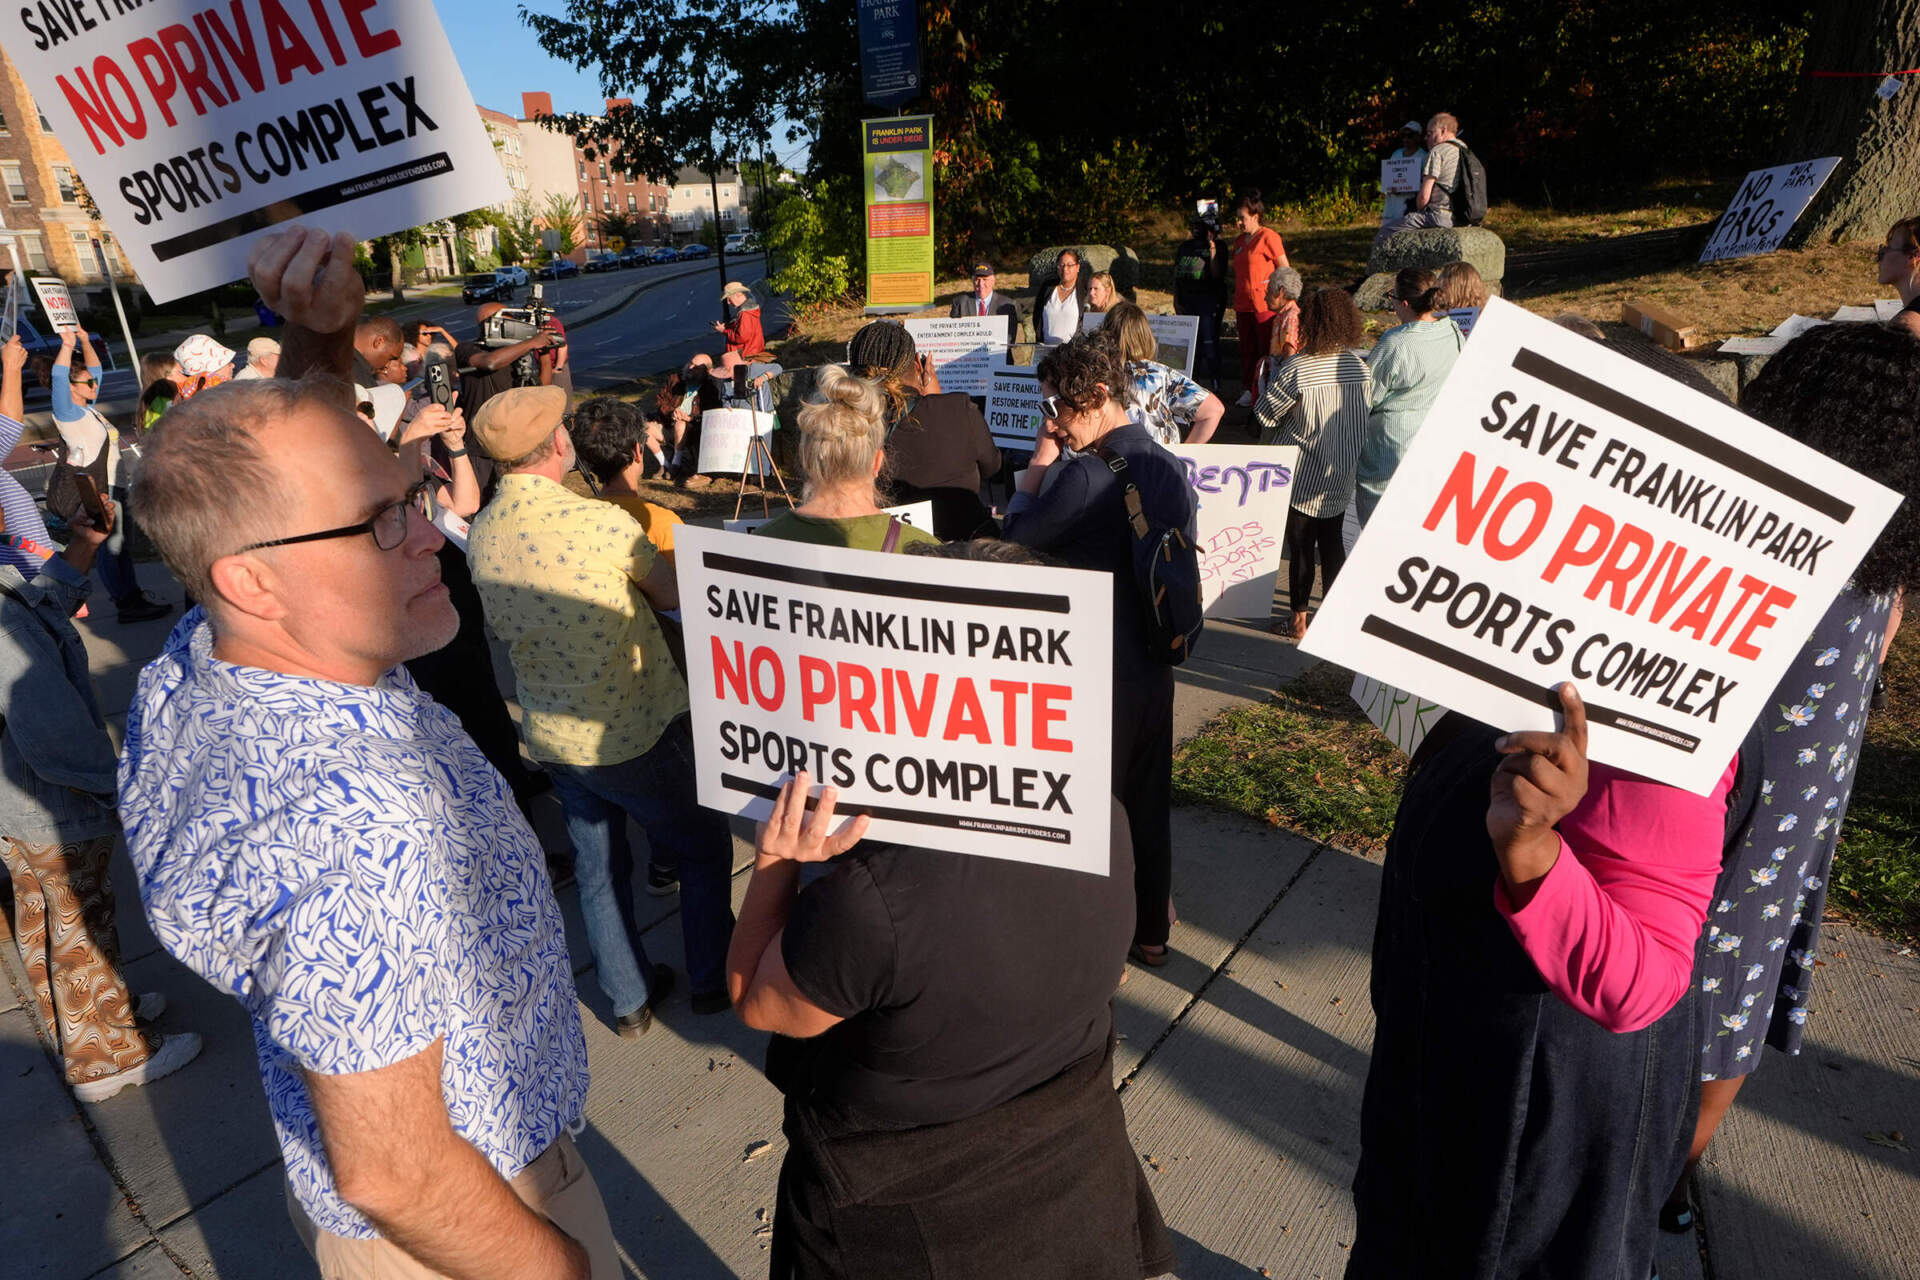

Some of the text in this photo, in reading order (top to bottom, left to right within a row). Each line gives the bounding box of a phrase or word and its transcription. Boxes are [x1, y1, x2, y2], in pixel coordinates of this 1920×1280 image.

[21, 0, 98, 51] SAVE
[55, 0, 402, 155] NO PRIVATE
[119, 76, 439, 225] SPORTS COMPLEX
[872, 126, 923, 137] FRANKLIN PARK
[1712, 199, 1785, 244] PROS
[1734, 172, 1817, 209] NO PARK
[990, 412, 1009, 428] FOR
[1011, 414, 1029, 429] THE
[992, 397, 1038, 410] RESTORE WHITE
[993, 382, 1011, 392] SAVE
[1012, 383, 1041, 394] FRANKLI
[1480, 391, 1834, 576] SAVE FRANKLIN PARK
[1422, 451, 1797, 661] NO PRIVATE
[706, 584, 1072, 666] SAVE FRANKLIN PARK
[1385, 556, 1738, 724] SPORTS COMPLEX
[711, 635, 1073, 754] NO PRIVATE
[720, 720, 1072, 814] SPORTS COMPLEX
[958, 819, 1066, 840] WWW.FRANKLINPARKDEFENDERS.COM
